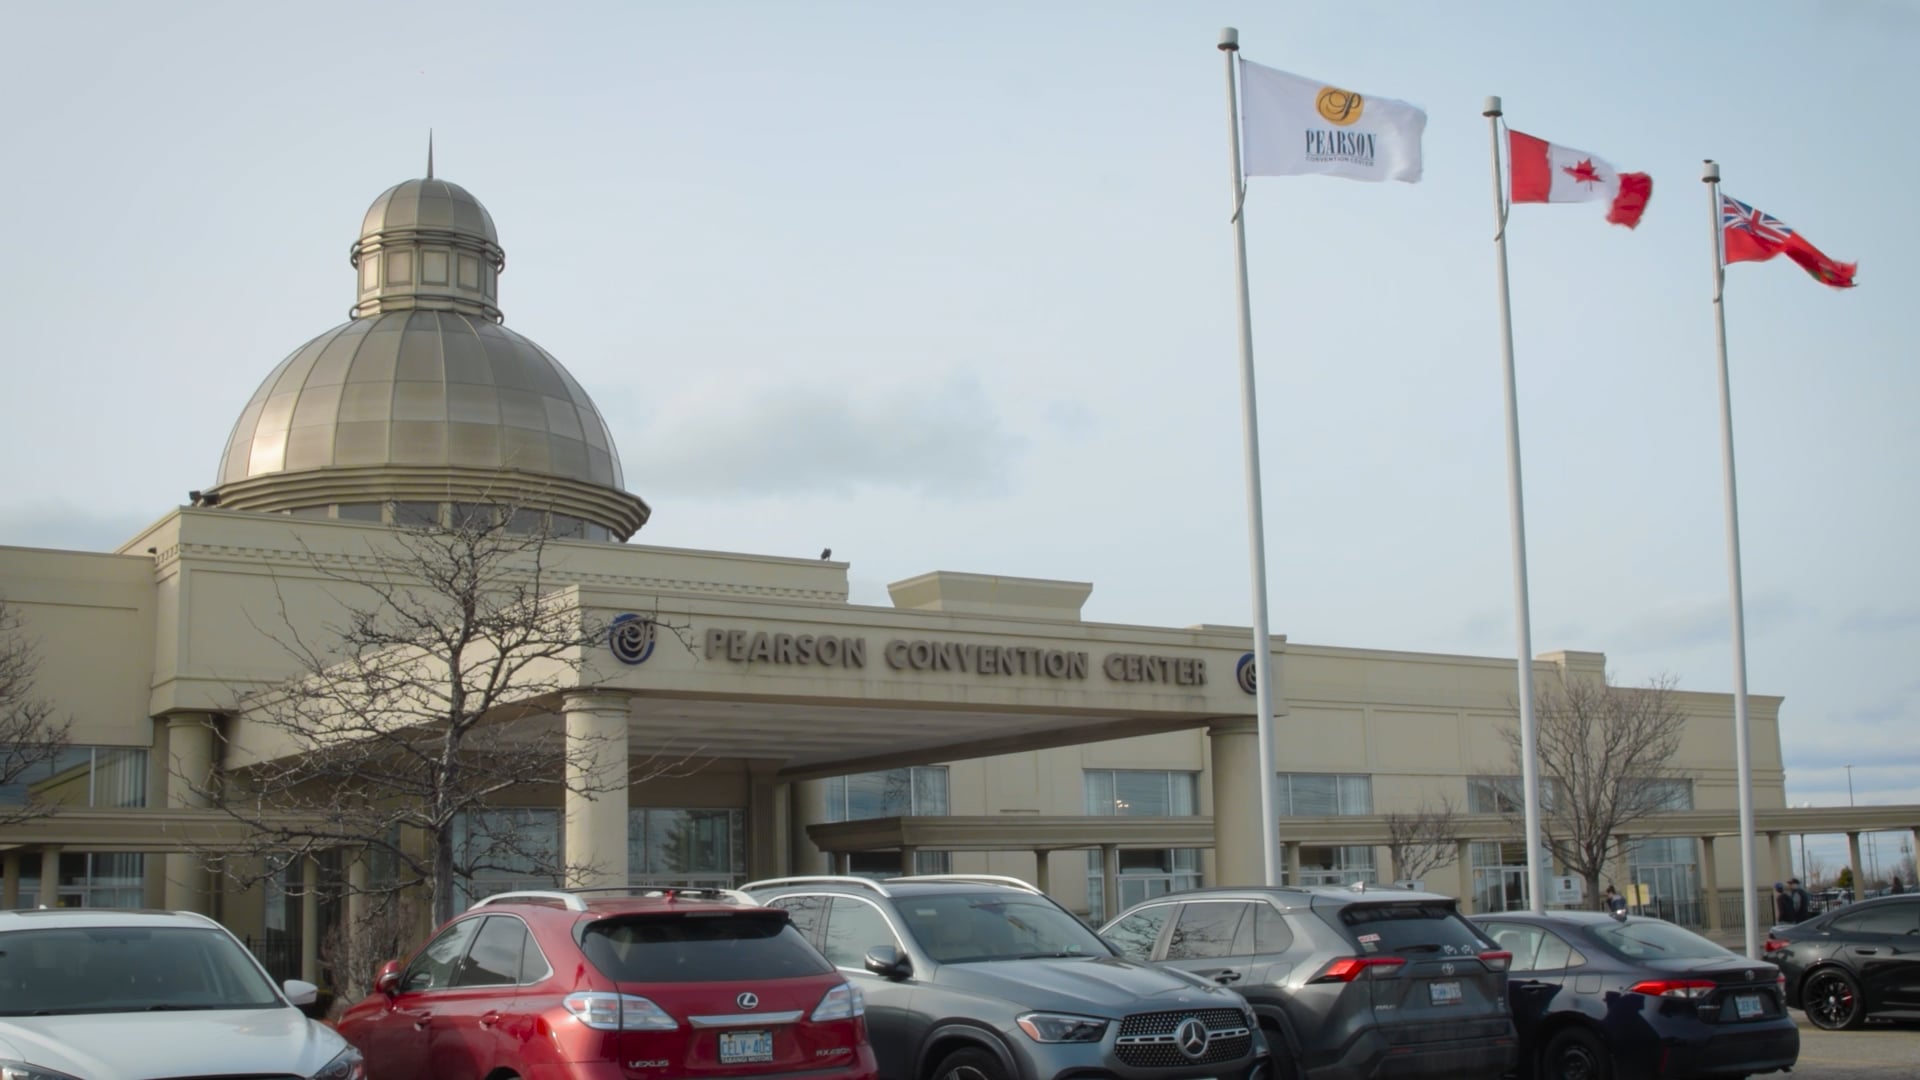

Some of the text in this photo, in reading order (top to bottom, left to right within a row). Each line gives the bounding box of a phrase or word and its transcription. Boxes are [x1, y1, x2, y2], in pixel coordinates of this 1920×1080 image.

[1305, 130, 1376, 158] PEARSON
[705, 627, 1208, 686] PEARSON CONVENTION CENTER
[628, 1059, 670, 1069] LEXUS
